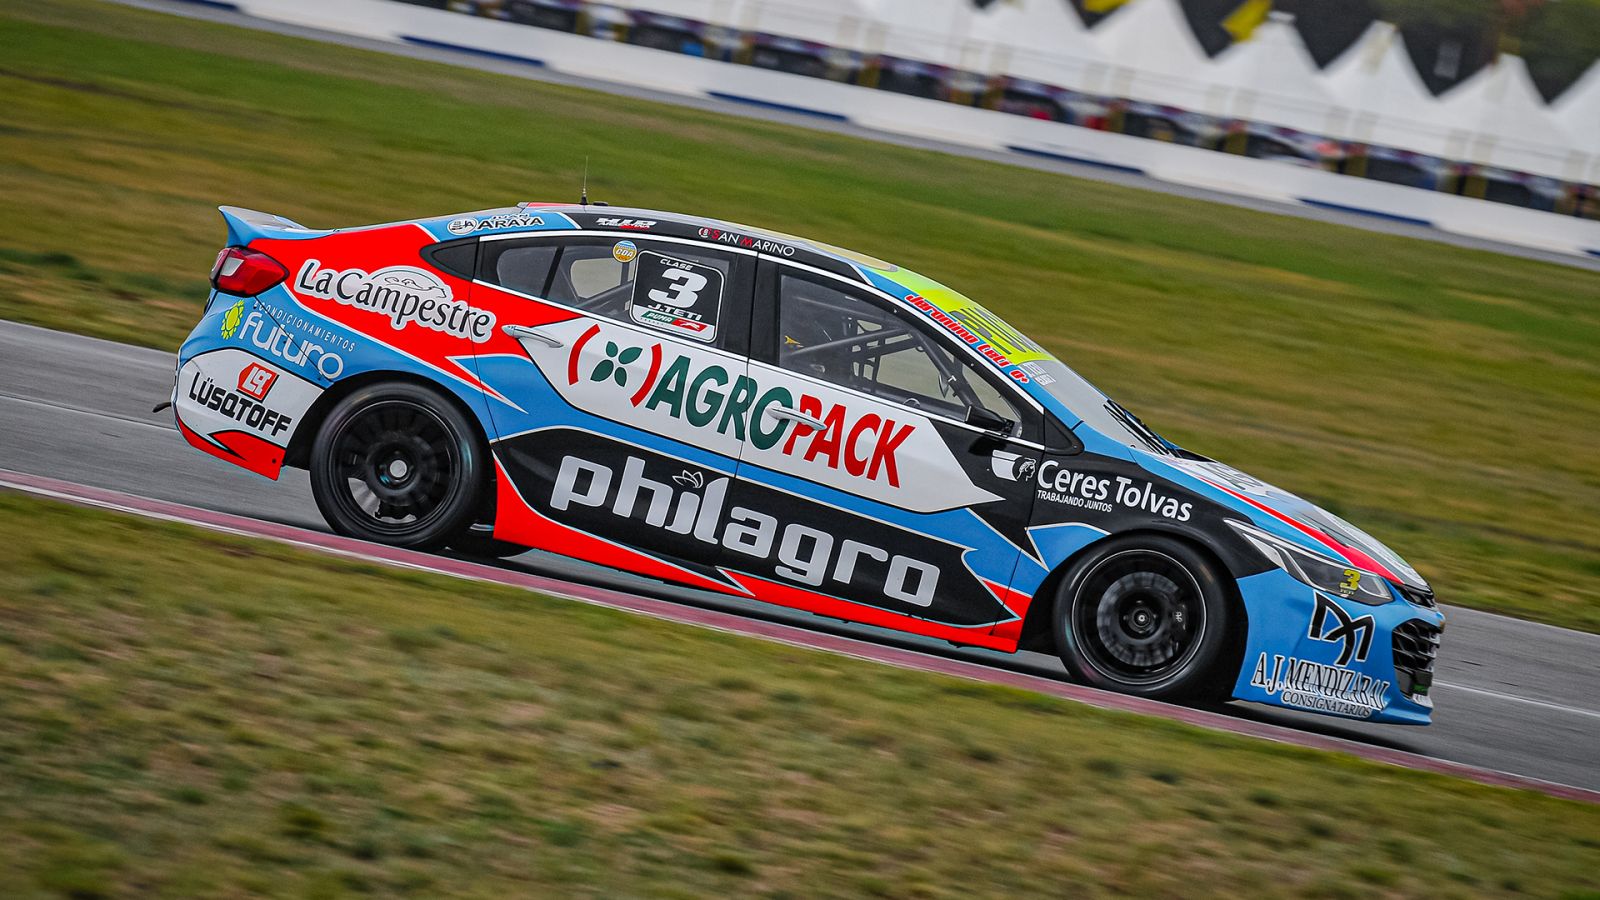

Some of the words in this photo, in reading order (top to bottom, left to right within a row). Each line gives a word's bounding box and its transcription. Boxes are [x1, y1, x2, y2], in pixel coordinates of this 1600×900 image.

[477, 216, 543, 230] ARAYA
[711, 229, 740, 245] SAN
[740, 237, 796, 257] MARINO
[659, 258, 693, 271] CLASE
[299, 262, 334, 295] La
[336, 272, 490, 337] Campestre
[647, 268, 708, 308] 3
[647, 303, 703, 321] J.TETI
[239, 311, 344, 380] futuro
[188, 372, 293, 437] LÜSQTOFF
[645, 353, 916, 489] AGROPACK
[1036, 460, 1111, 501] Ceres
[1115, 476, 1194, 522] Tolvas
[1036, 489, 1084, 508] TRABAJANDO
[1084, 499, 1113, 513] JUNTOS
[549, 455, 942, 608] philagro
[1339, 568, 1361, 591] 3
[1250, 652, 1284, 694] A.J.
[1282, 690, 1372, 717] CONSIGNATARIOS
